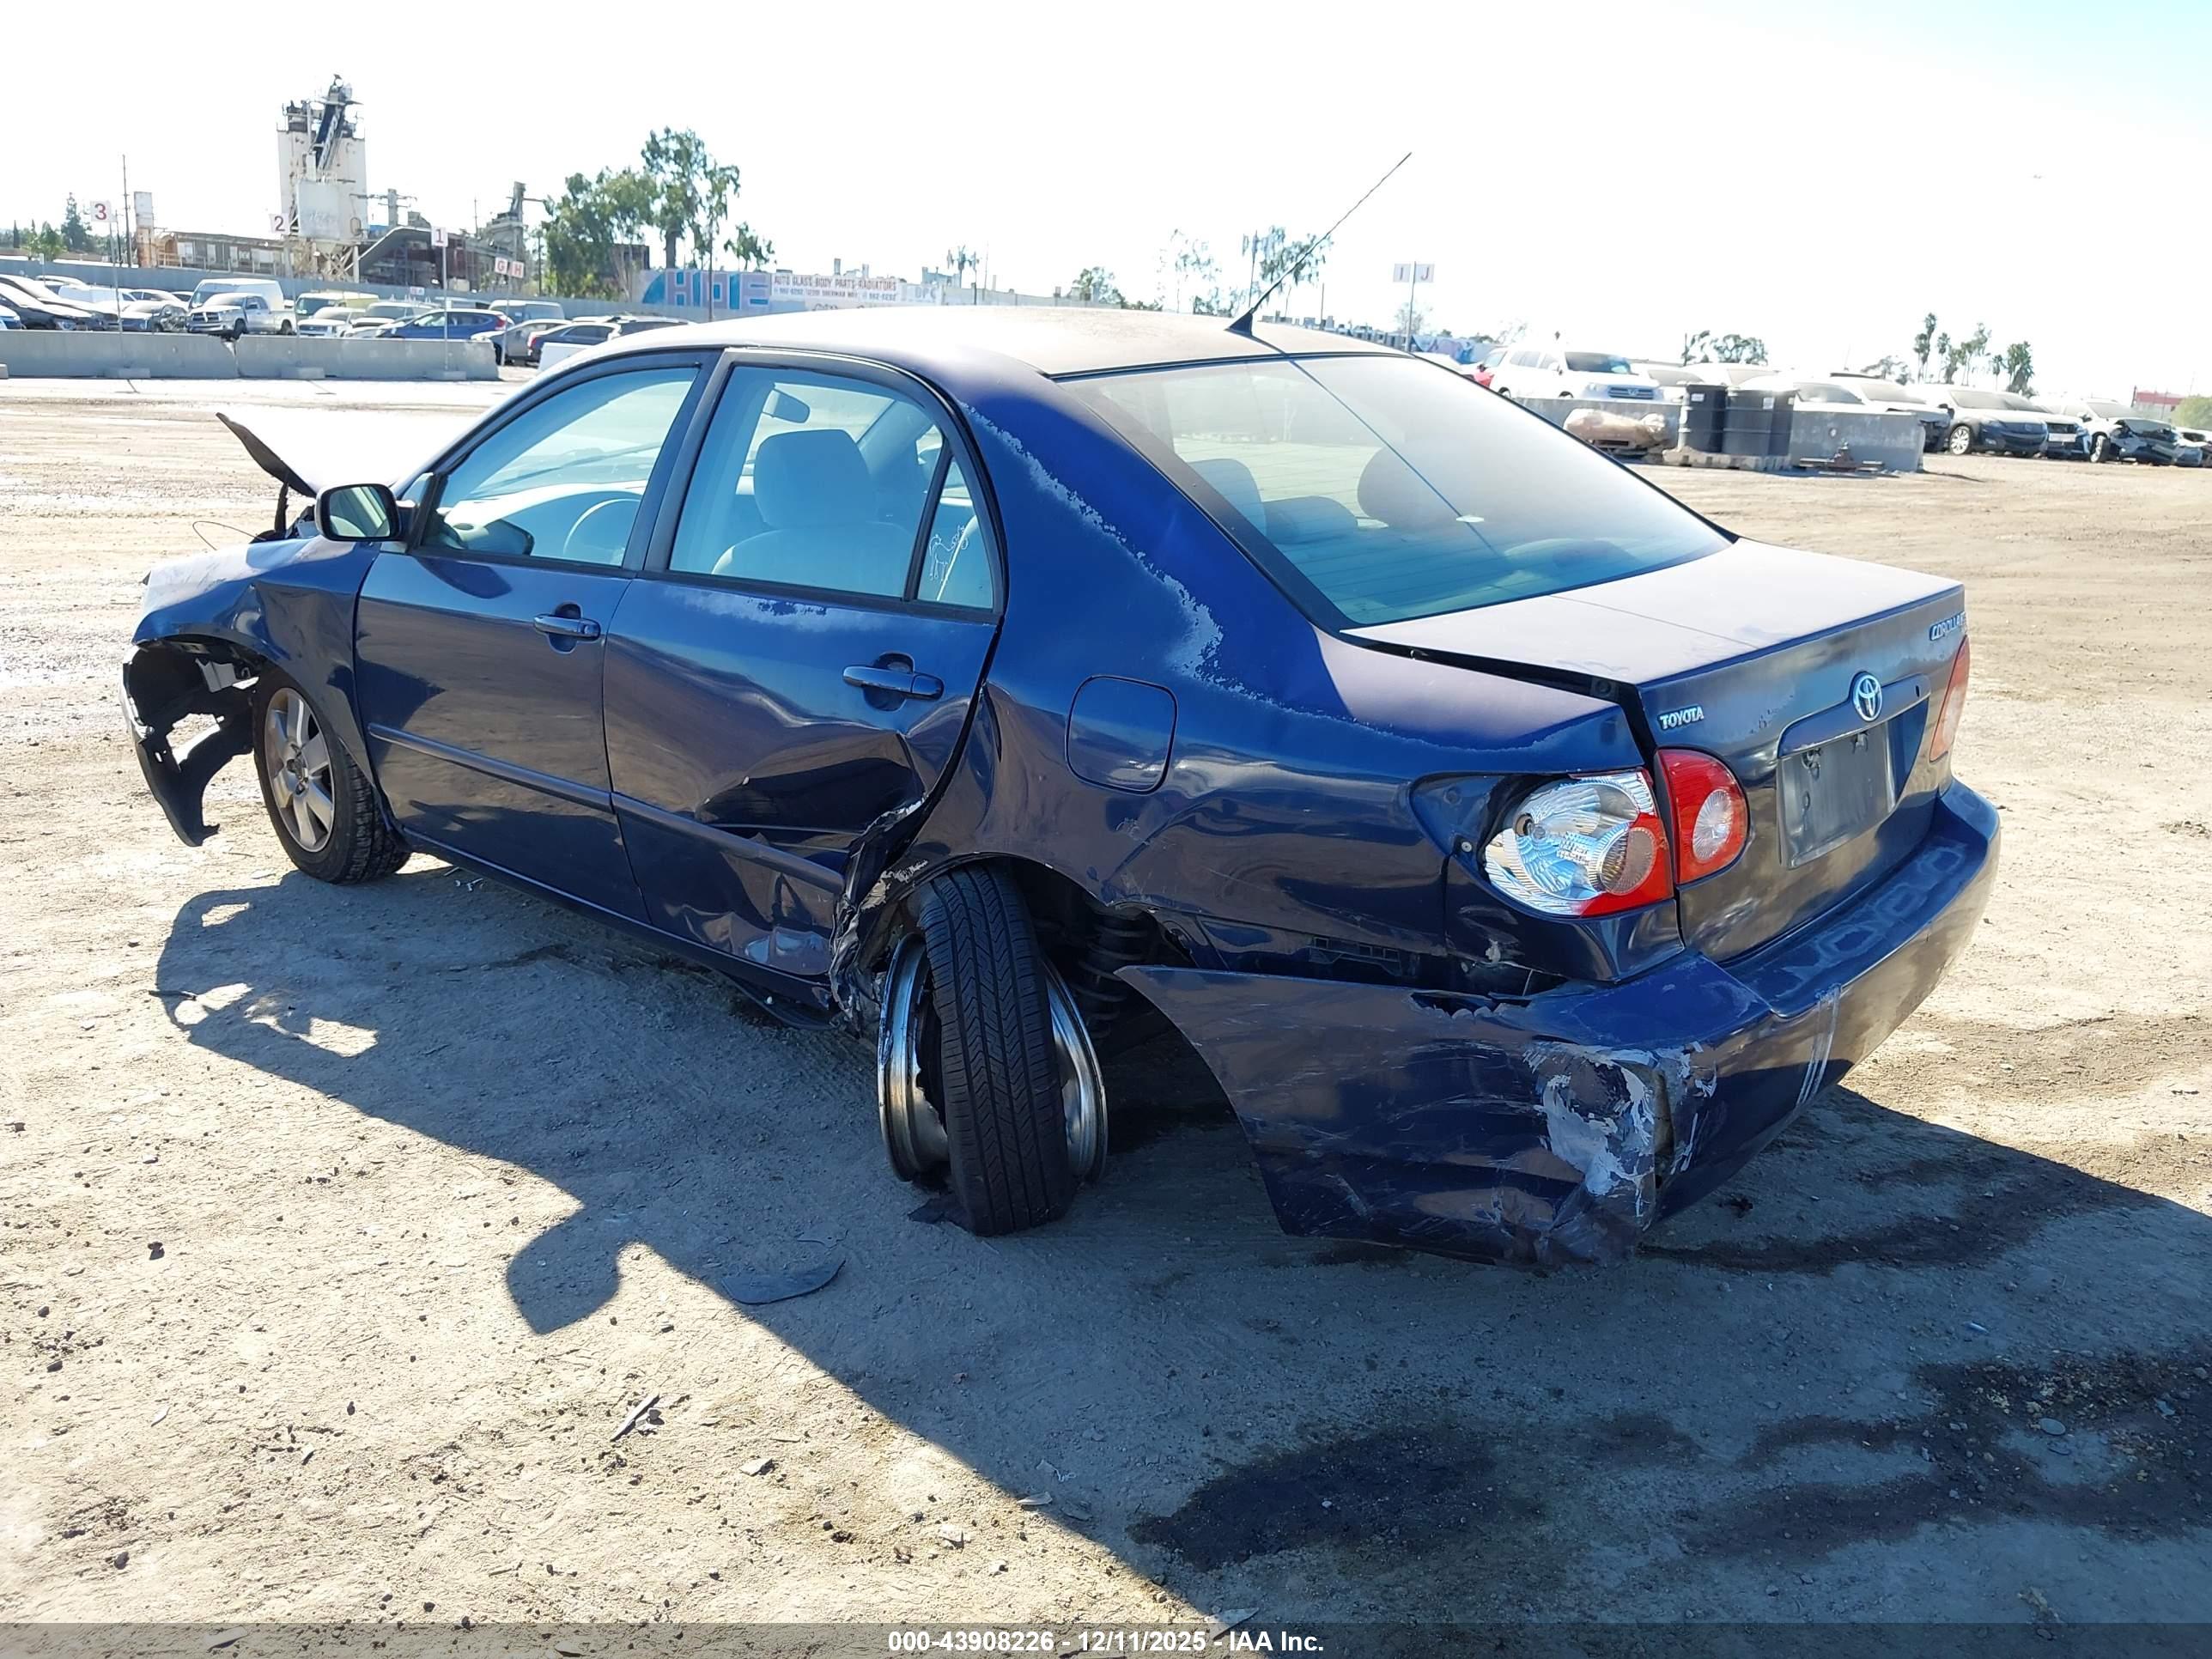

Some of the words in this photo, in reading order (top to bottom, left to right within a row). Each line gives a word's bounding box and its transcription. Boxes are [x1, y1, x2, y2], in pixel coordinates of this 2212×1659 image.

[94, 204, 106, 221] 3
[274, 216, 286, 232] 2
[435, 228, 444, 243] 1
[497, 260, 505, 271] G
[514, 262, 523, 274] H
[1420, 267, 1429, 281] J
[1659, 706, 1705, 730] TOYOTA
